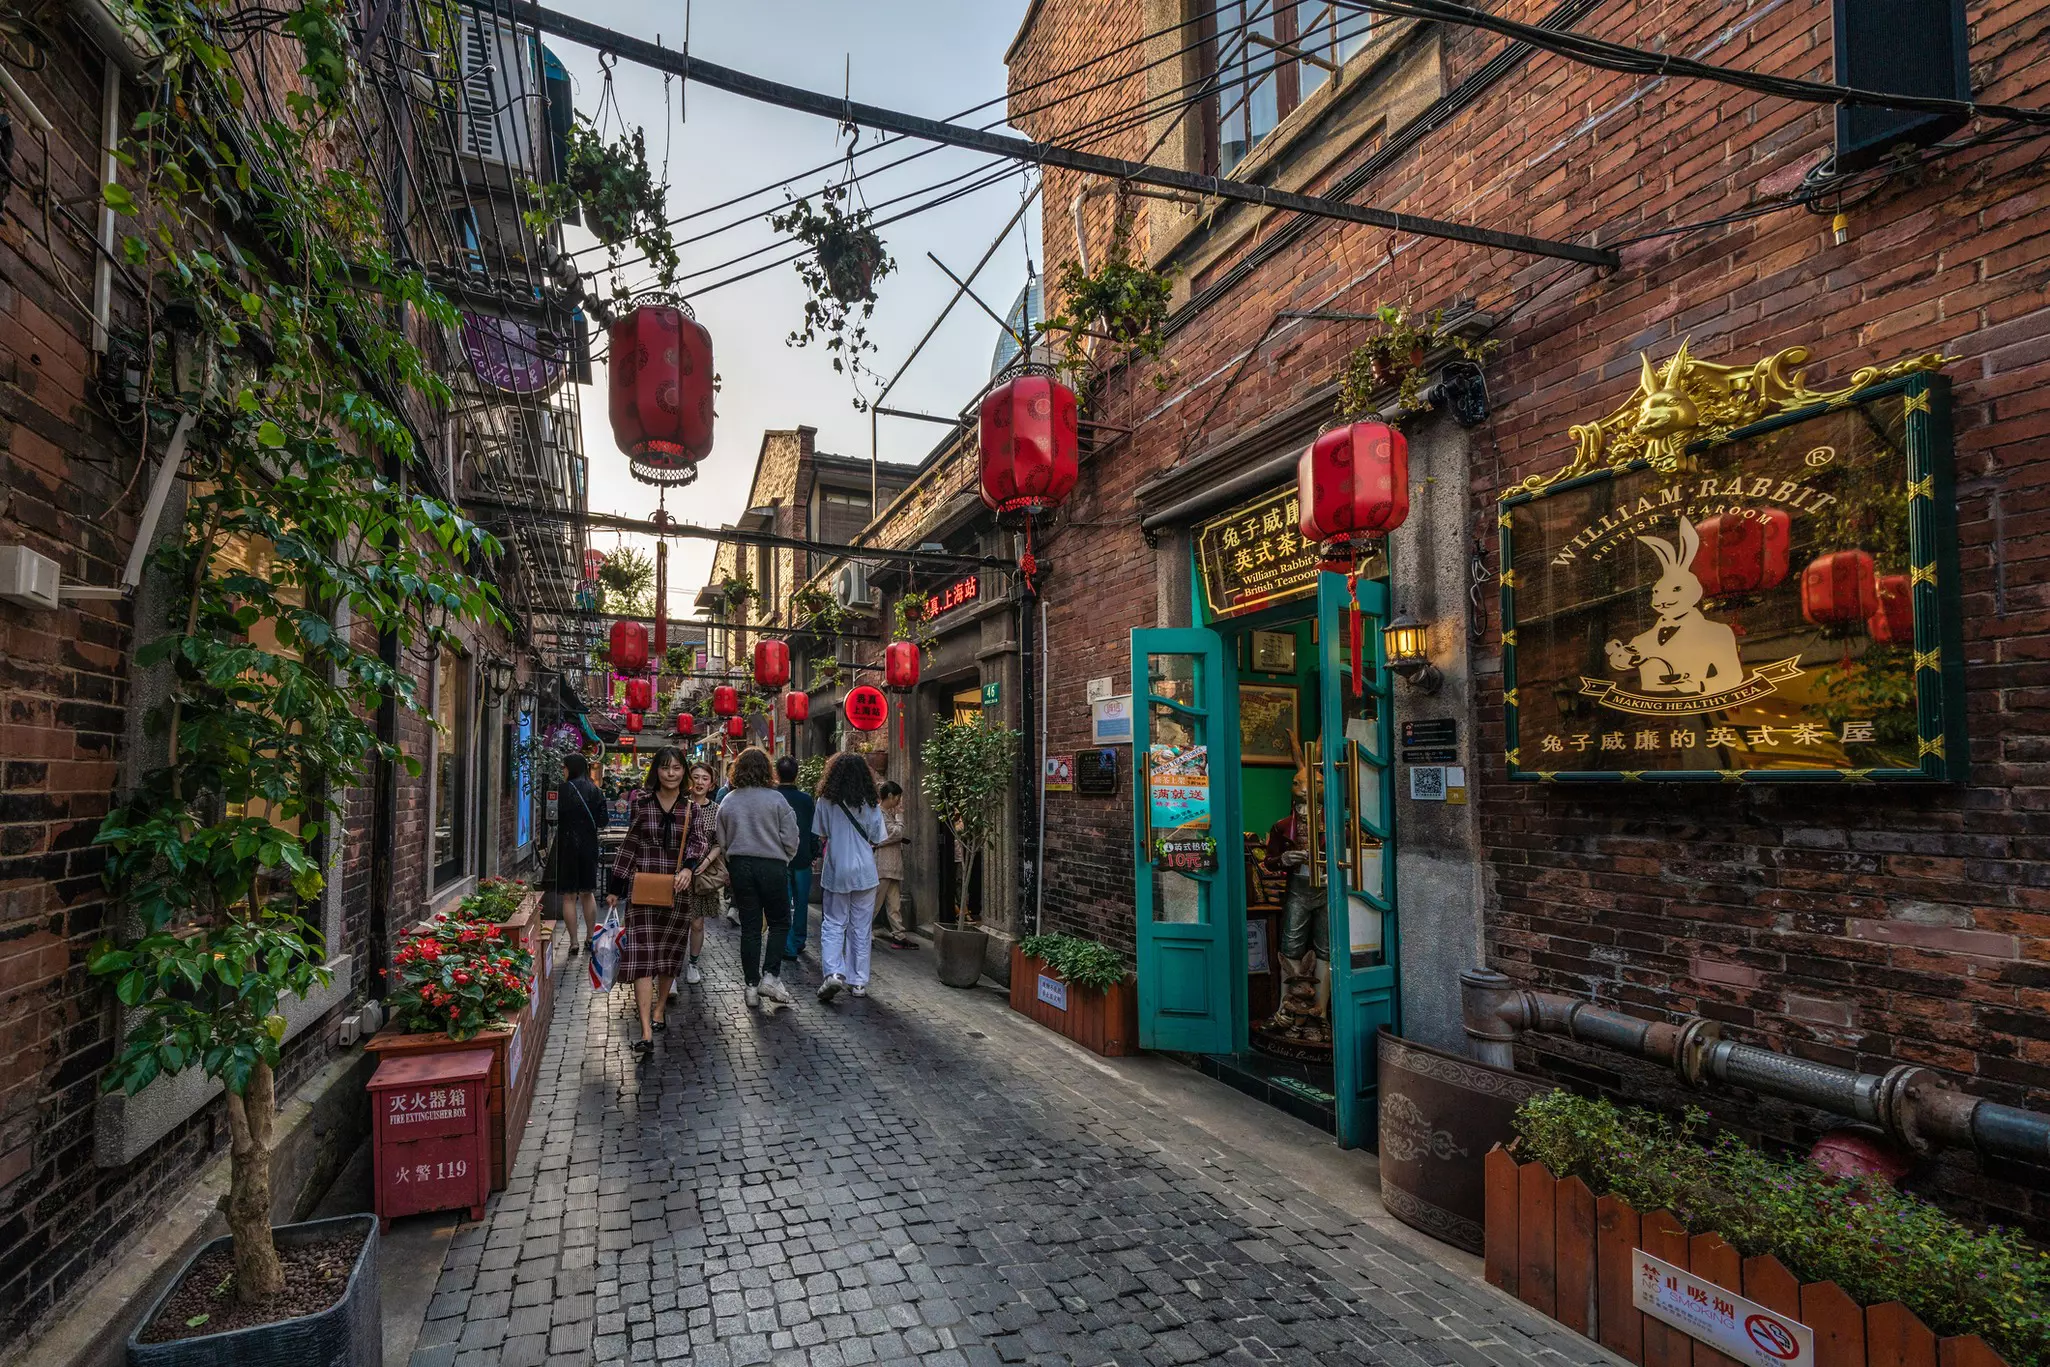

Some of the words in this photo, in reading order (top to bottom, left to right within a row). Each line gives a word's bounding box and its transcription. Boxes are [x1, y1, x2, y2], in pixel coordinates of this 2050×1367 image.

[1592, 513, 1660, 561] BRITISH
[1672, 504, 1773, 526] TEAROOM
[1242, 567, 1278, 585] William
[1280, 554, 1320, 574] Rabbit's
[1245, 581, 1273, 597] British
[1275, 568, 1321, 587] Tearoom
[987, 686, 995, 698] 46
[1612, 696, 1662, 710] MAKING
[1666, 695, 1729, 710] HEALTHY
[1731, 685, 1762, 700] TEA
[1541, 721, 1877, 753] 兔子威廉的英式茶屋
[1172, 757, 1184, 768] TEA
[1153, 788, 1206, 801] 满就送
[390, 1089, 466, 1112] 灭火器箱
[389, 1114, 405, 1125] FIRE
[406, 1109, 452, 1123] EXTINGUISHER
[453, 1107, 467, 1118] BOX
[395, 1164, 431, 1185] 火警
[436, 1160, 467, 1180] 119
[1642, 1263, 1735, 1320] 禁止吸烟
[1642, 1278, 1662, 1294] NO
[1669, 1293, 1735, 1331] SMOKING
